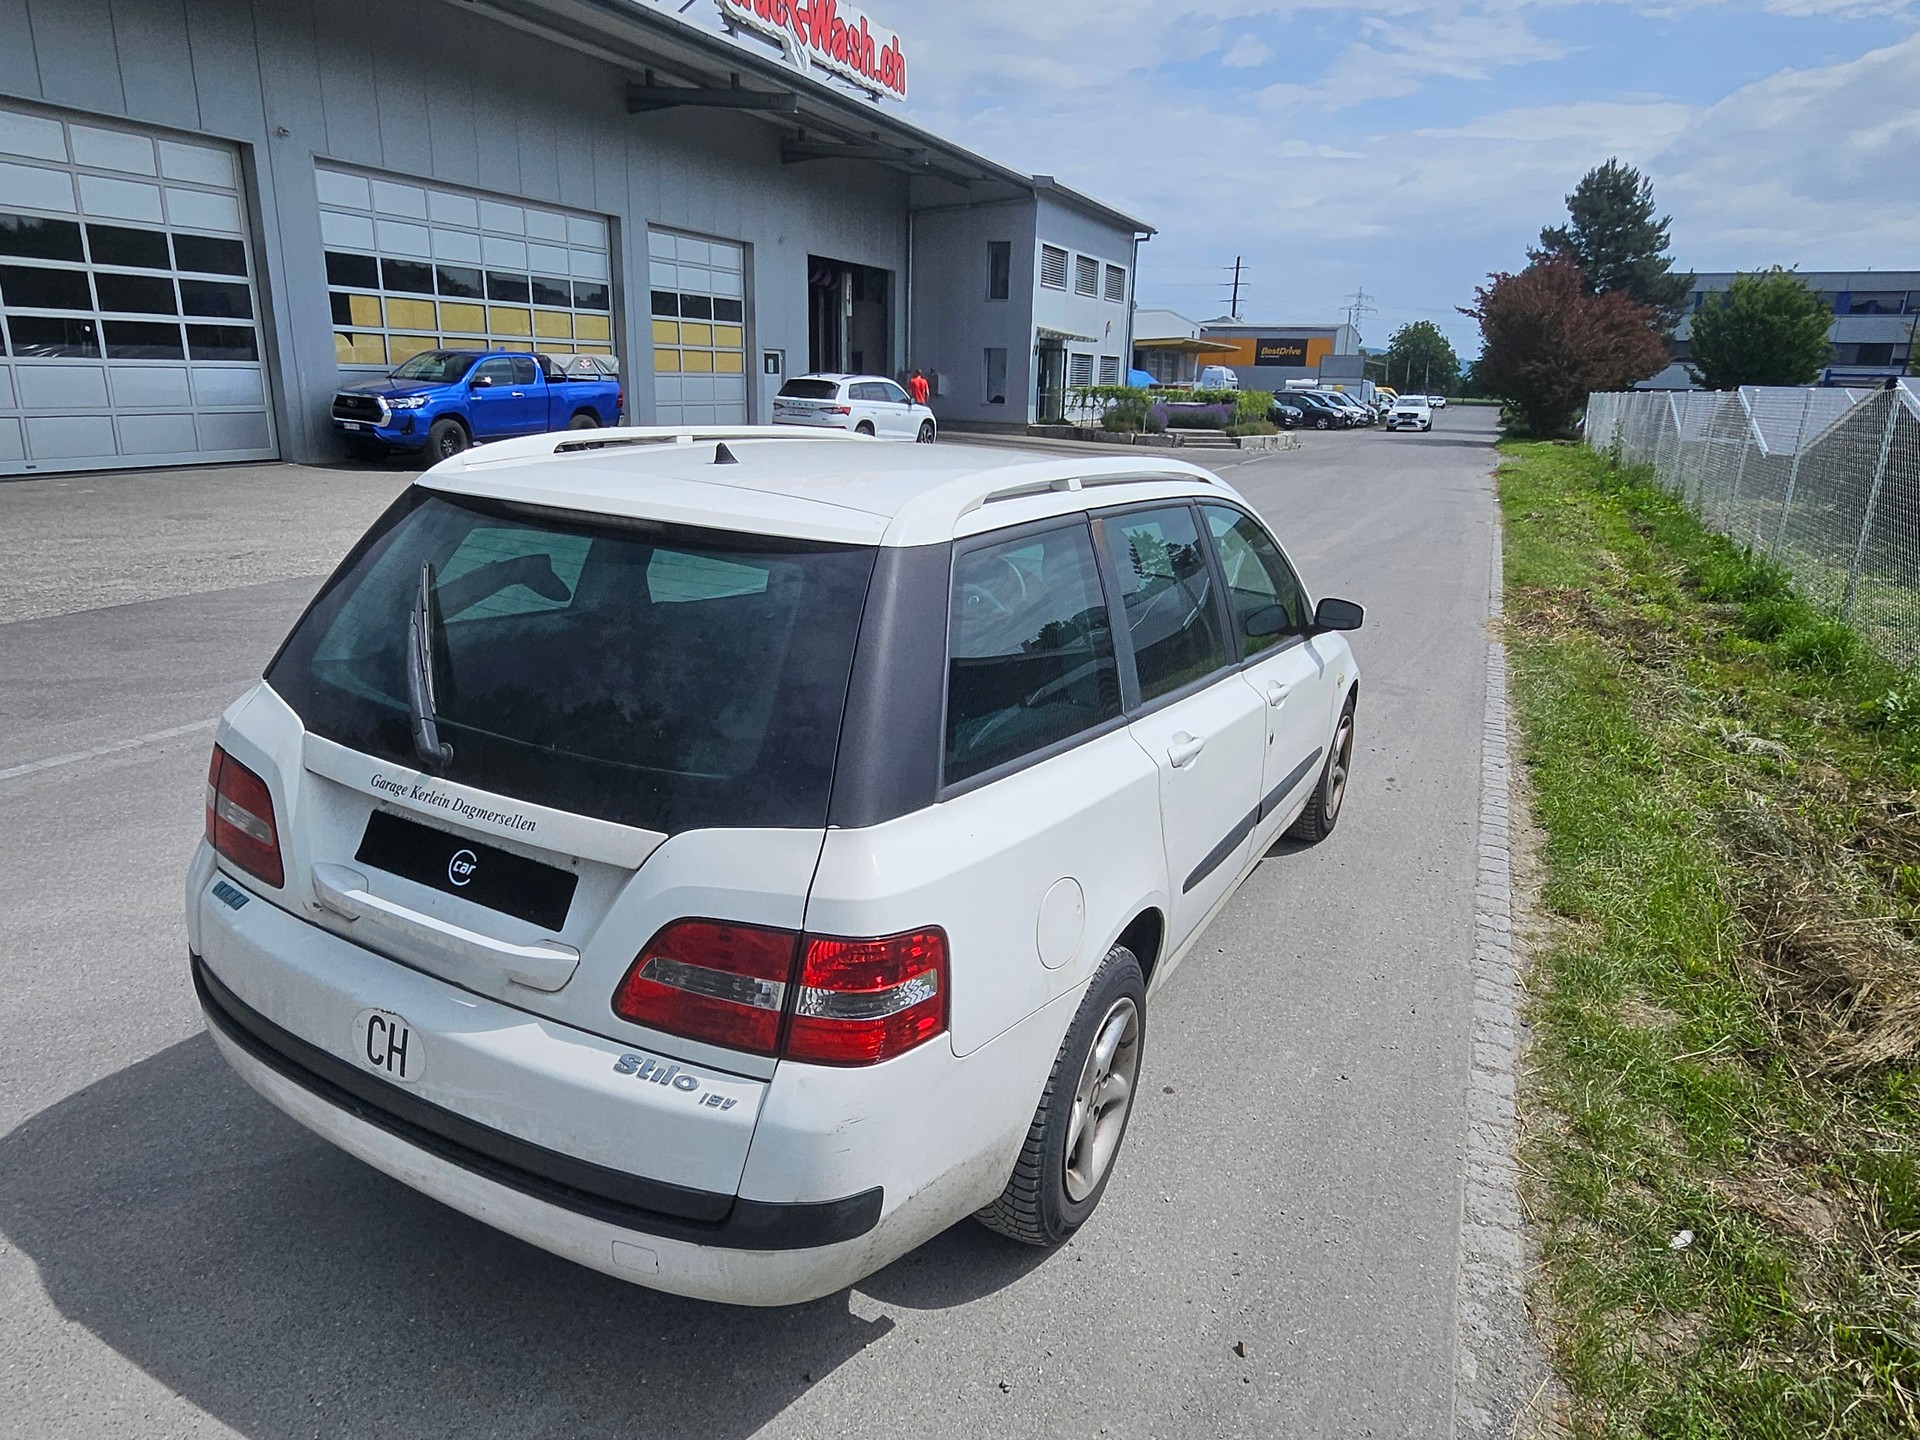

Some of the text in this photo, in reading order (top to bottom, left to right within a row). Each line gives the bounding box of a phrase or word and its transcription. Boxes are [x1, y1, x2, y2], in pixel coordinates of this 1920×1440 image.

[731, 0, 905, 95] uck-Wash.ch
[1261, 346, 1301, 355] BestDrive
[370, 773, 537, 832] Garage Kerlein Dagmersellen
[366, 1014, 409, 1078] CH
[612, 1053, 700, 1092] Stilo
